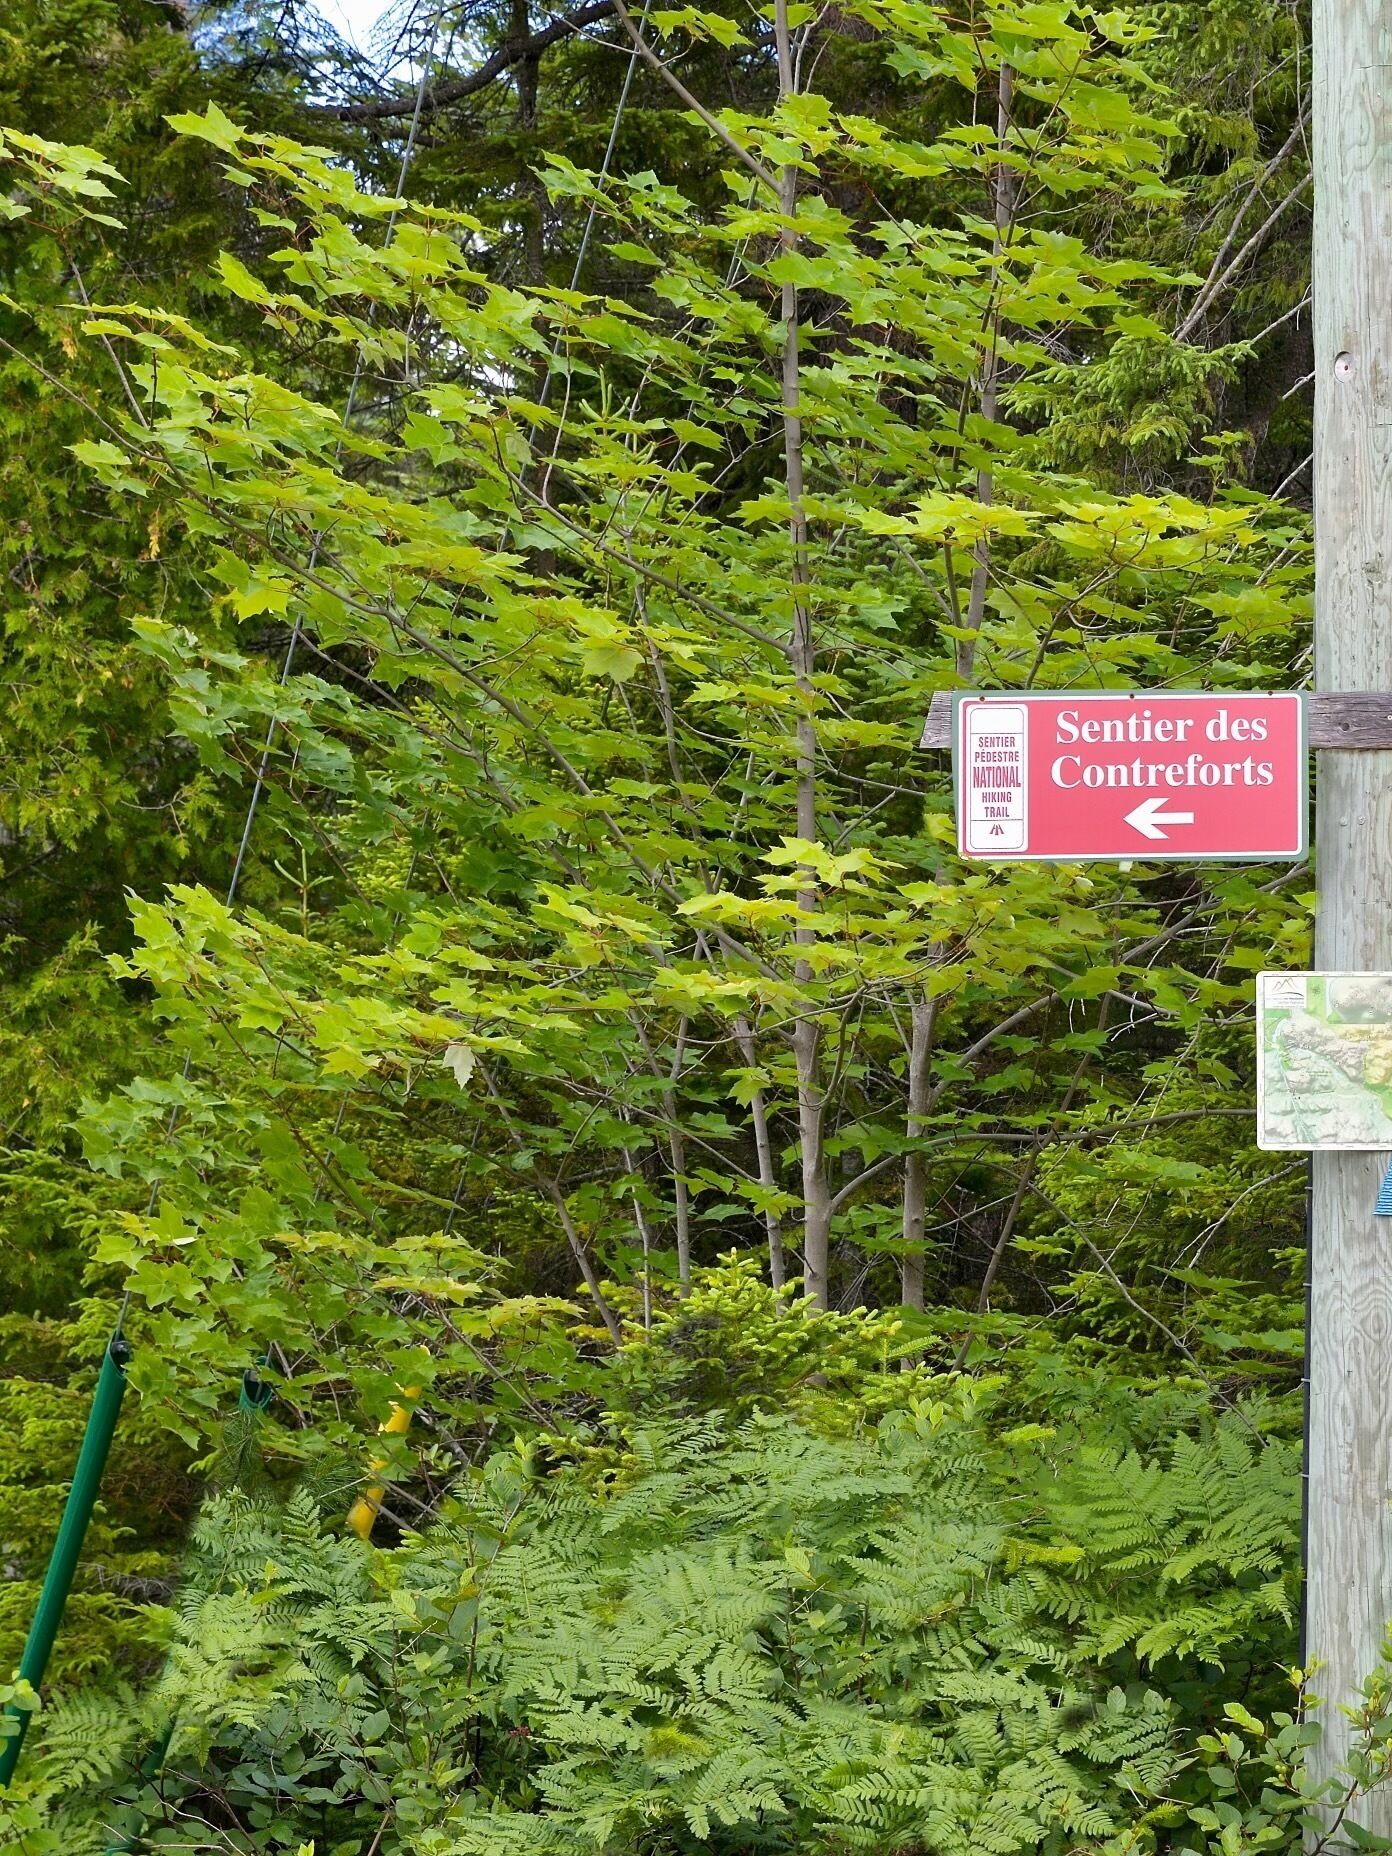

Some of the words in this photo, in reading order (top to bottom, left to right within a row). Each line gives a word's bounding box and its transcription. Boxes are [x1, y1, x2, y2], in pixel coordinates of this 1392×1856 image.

[1056, 709, 1194, 744] Sentier
[1205, 709, 1268, 742] des
[978, 736, 1016, 748] SENTIER
[974, 748, 1020, 762] PÉDESTRE
[973, 765, 1021, 788] NATIONAL
[1051, 753, 1274, 789] Contreforts
[981, 791, 1012, 803] HIKING
[984, 806, 1010, 818] TRAIL
